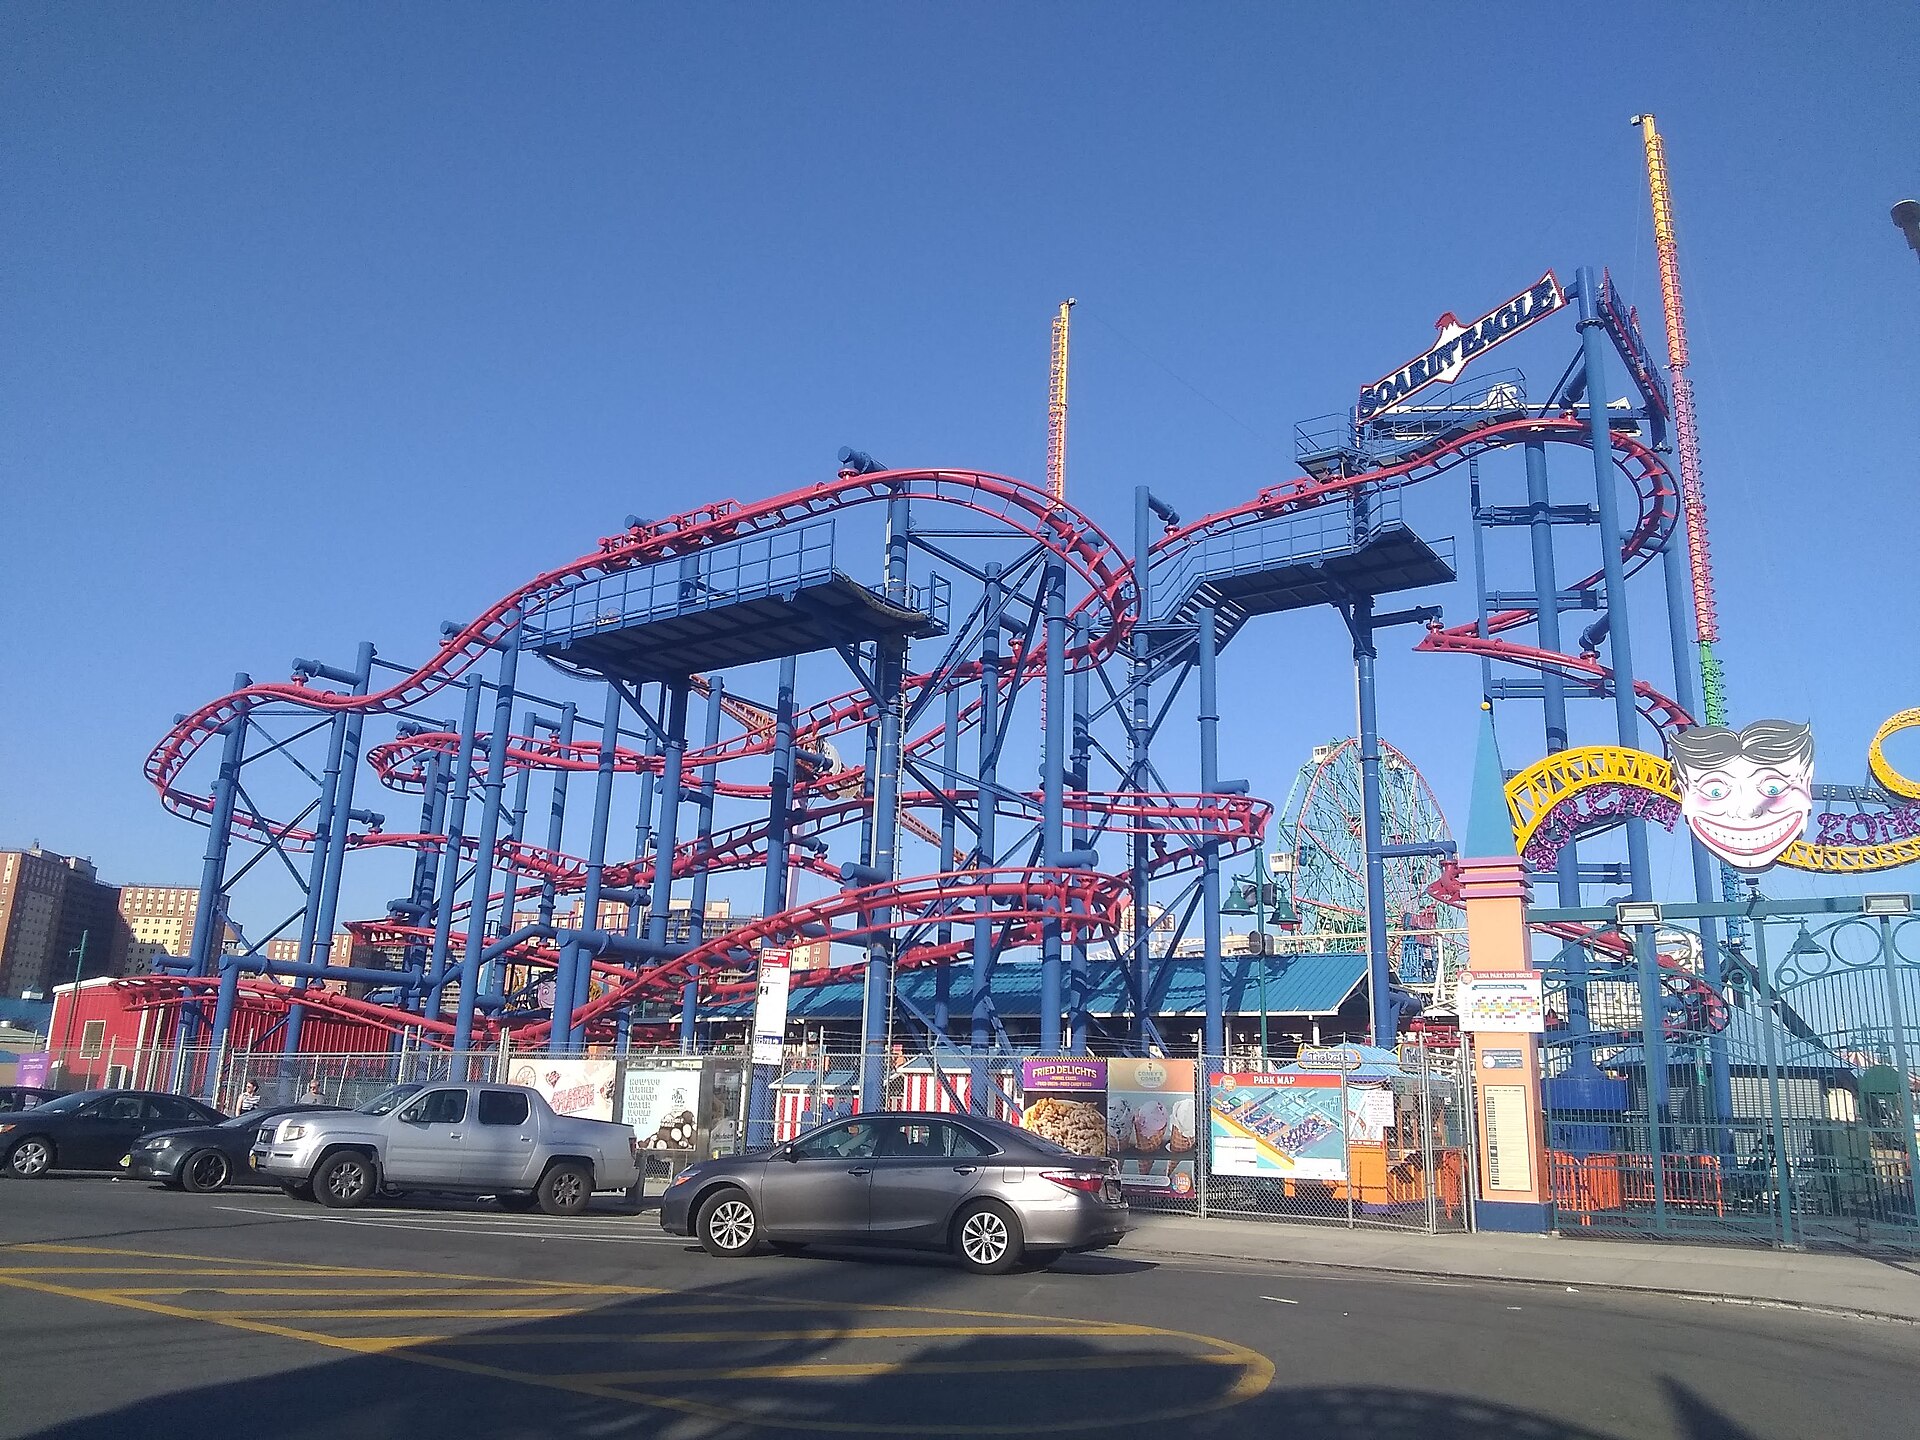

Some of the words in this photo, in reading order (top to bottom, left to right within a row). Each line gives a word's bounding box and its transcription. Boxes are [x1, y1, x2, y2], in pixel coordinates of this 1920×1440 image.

[1460, 278, 1557, 361] EAGLE
[1525, 785, 1681, 873] SCREAM
[1032, 1065, 1056, 1079] FRIED
[1056, 1065, 1097, 1079] DELIGHTS
[1253, 1075, 1275, 1085] PARK
[1276, 1076, 1296, 1085] MAP
